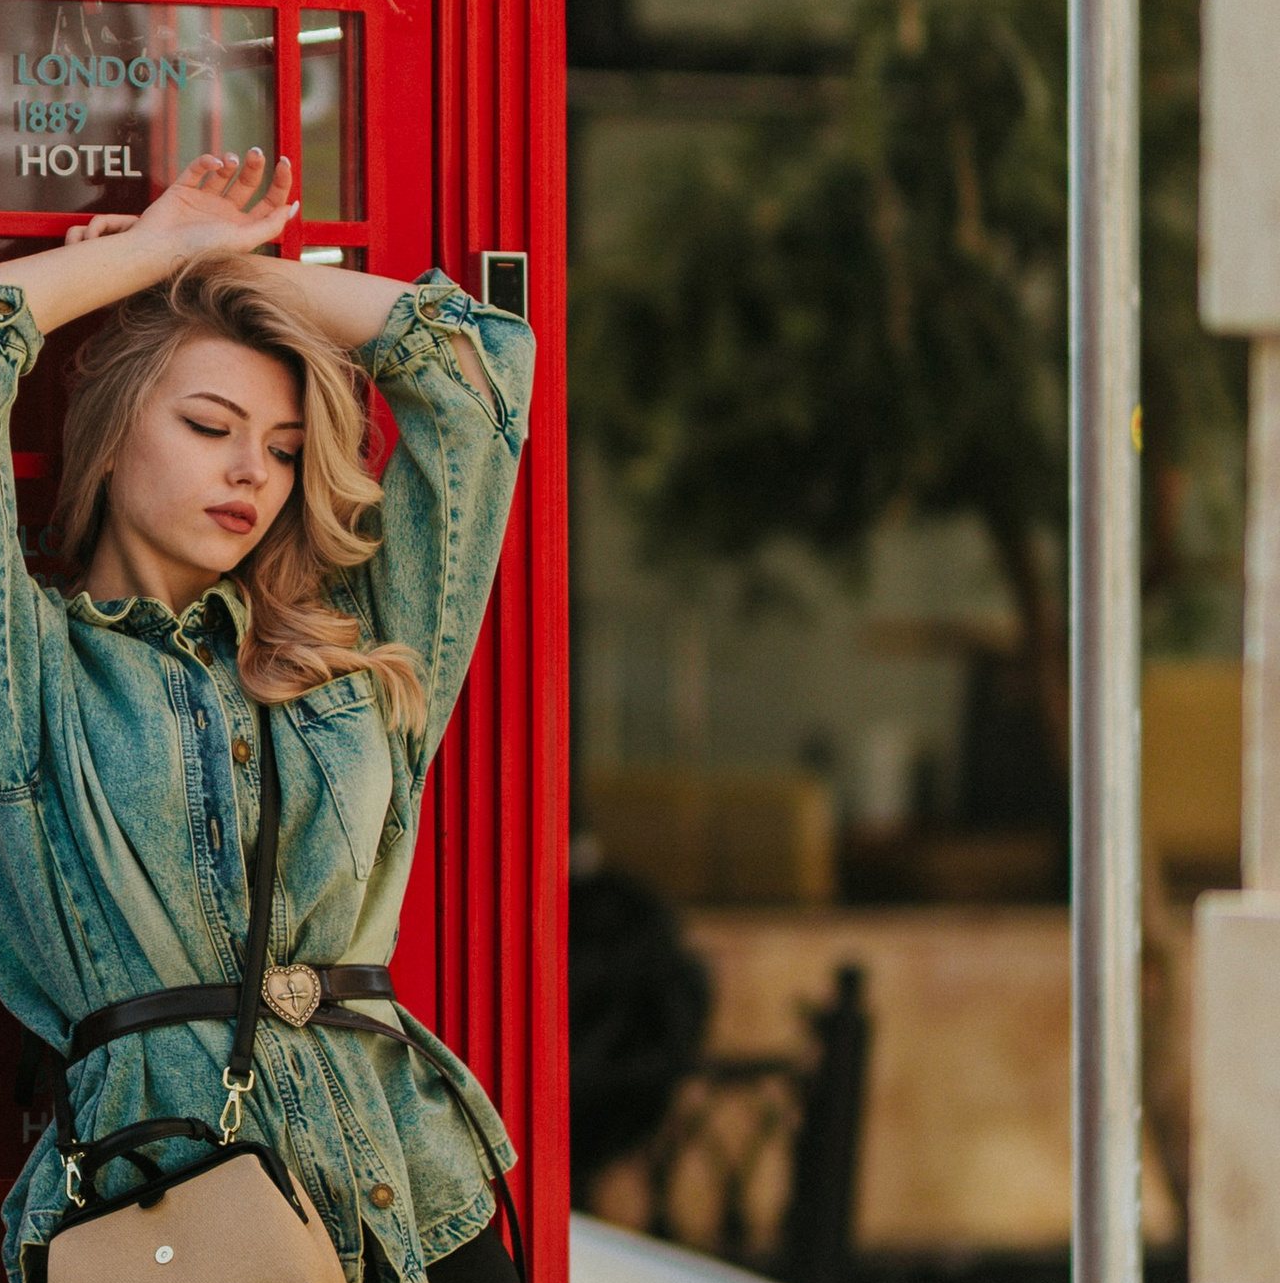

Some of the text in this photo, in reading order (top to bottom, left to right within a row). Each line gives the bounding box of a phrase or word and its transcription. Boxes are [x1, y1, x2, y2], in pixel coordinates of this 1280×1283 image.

[18, 54, 187, 90] LONDON
[19, 100, 88, 134] 1889
[21, 144, 143, 177] HOTEL
